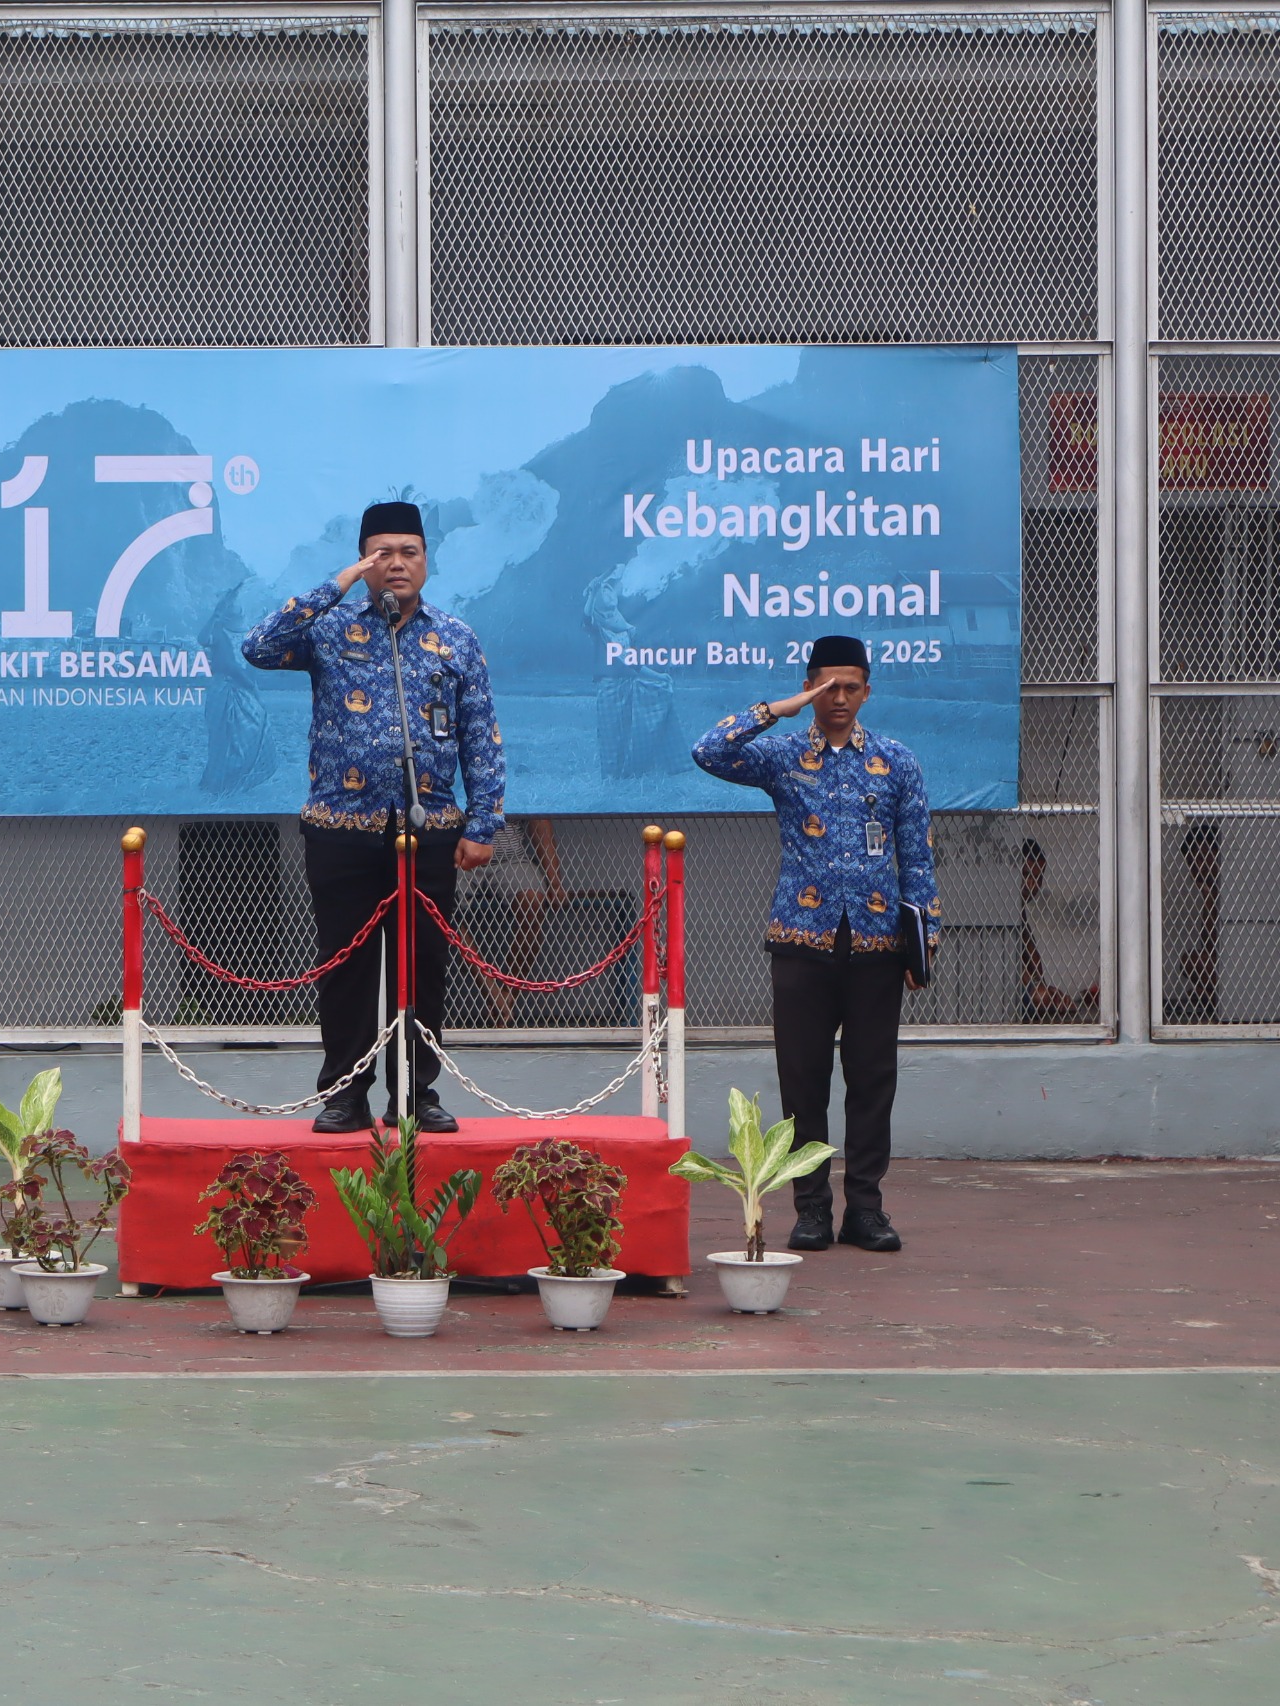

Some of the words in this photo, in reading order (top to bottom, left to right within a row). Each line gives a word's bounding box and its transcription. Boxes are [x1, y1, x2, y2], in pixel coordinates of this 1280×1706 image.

[687, 439, 845, 481] Upacara
[861, 437, 941, 473] Hari
[624, 490, 941, 551] Kebangkitan
[724, 570, 940, 617] Nasional
[61, 650, 212, 678] BERSAMA
[606, 642, 698, 666] Pancur
[707, 642, 775, 669] Batu,
[881, 640, 942, 663] 2025
[33, 687, 147, 707] INDONESIA
[154, 686, 206, 706] KUAT
